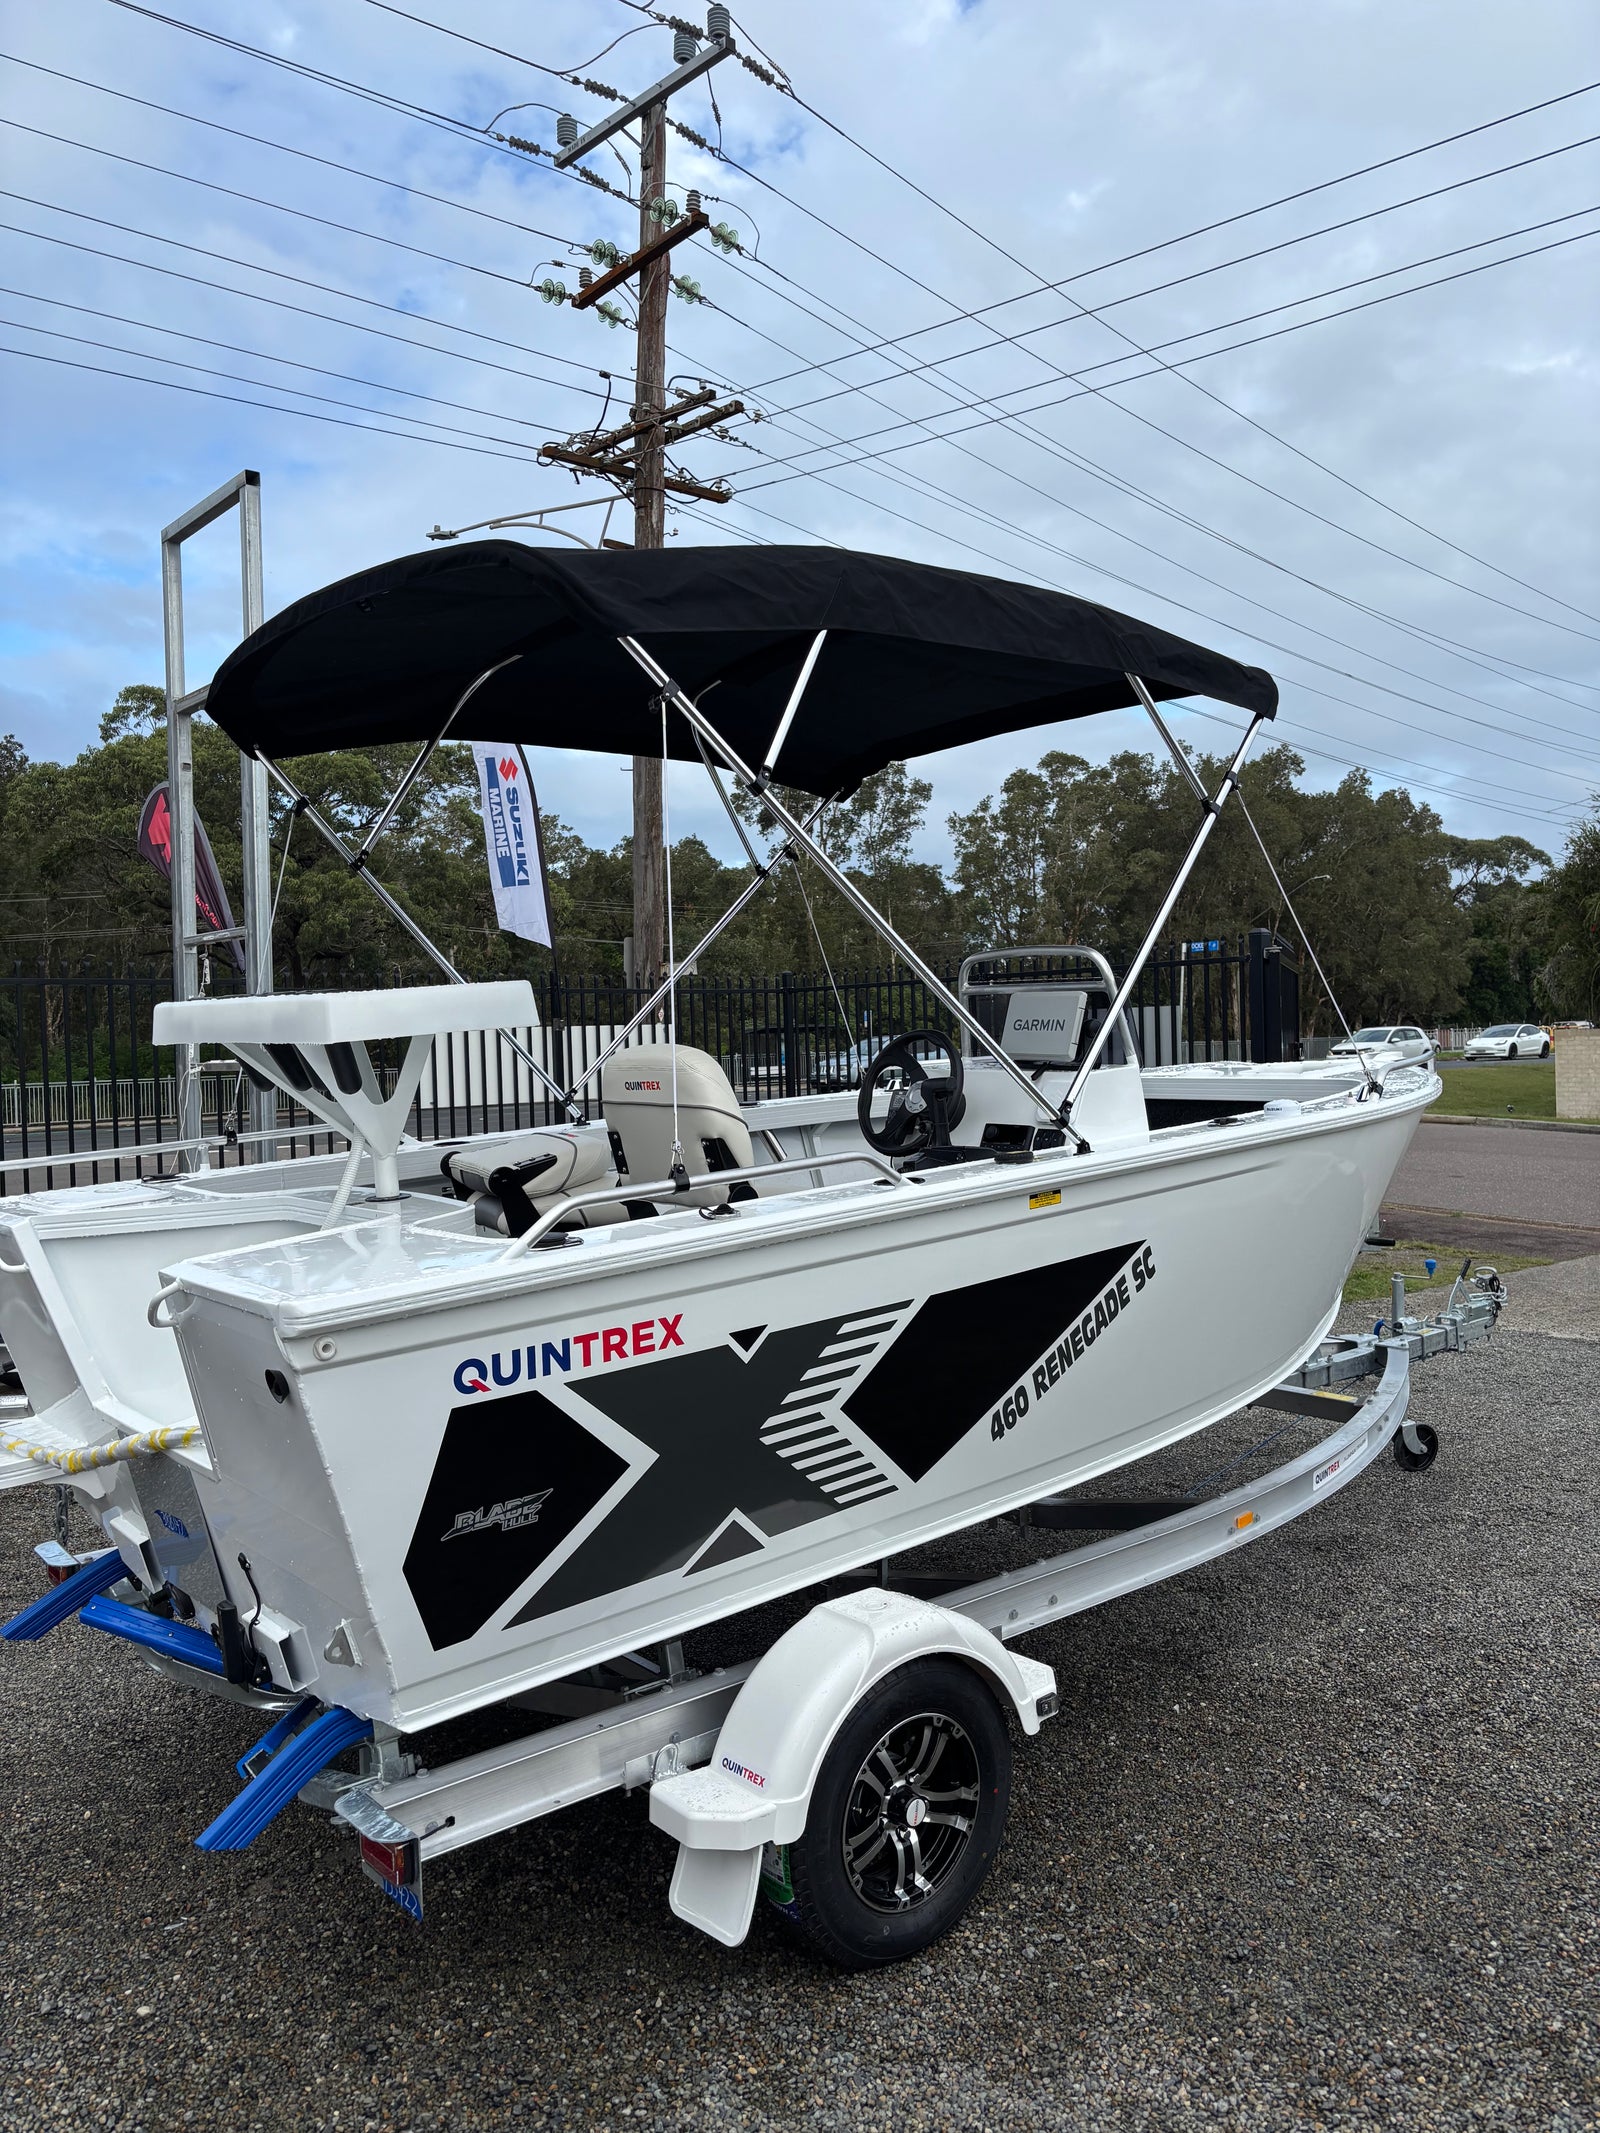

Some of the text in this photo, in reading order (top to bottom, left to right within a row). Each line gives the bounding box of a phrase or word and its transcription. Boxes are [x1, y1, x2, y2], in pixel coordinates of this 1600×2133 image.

[488, 787, 510, 858] MARINE
[505, 786, 530, 886] SUZUKI
[1013, 1018, 1066, 1032] GARMIN
[624, 1080, 661, 1091] QUINTREX
[453, 1313, 685, 1395] QUINTREX
[990, 1245, 1156, 1442] 460 RENEGADE SC
[1315, 1460, 1340, 1485] QUINTREX
[446, 1491, 549, 1536] BLADE
[502, 1513, 539, 1530] HULL
[722, 1757, 766, 1788] QUINTREX
